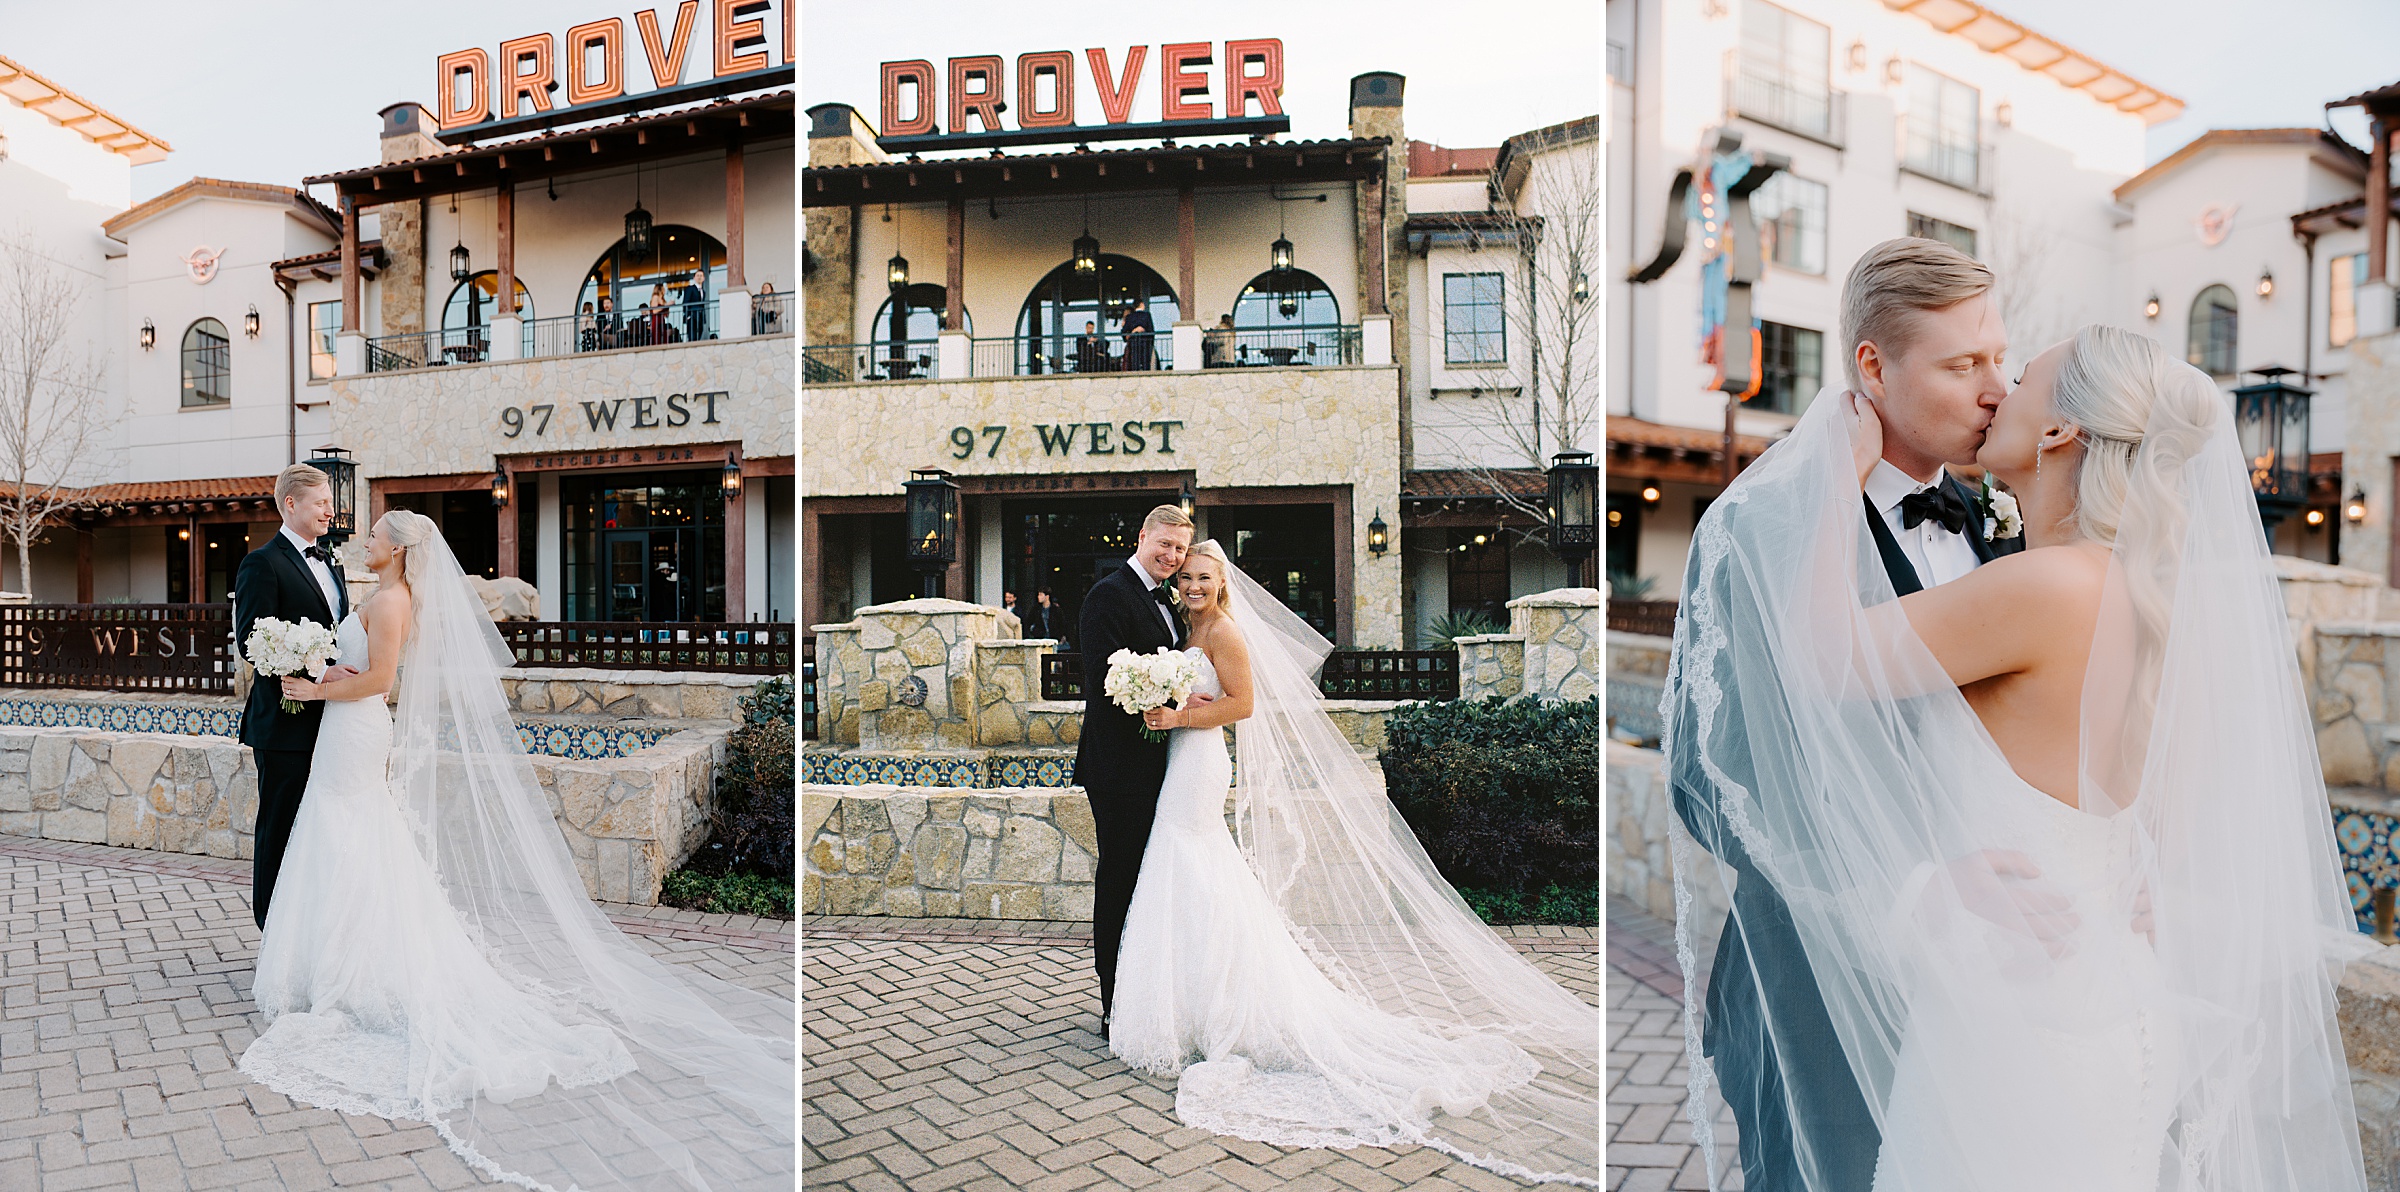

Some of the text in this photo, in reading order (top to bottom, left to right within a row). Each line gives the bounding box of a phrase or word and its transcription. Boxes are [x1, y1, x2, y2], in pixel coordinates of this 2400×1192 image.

[879, 37, 1285, 137] DROVER
[501, 390, 730, 439] 97 WEST
[950, 419, 1184, 460] 97 WEST
[534, 449, 694, 468] KITCHEN & BAR
[984, 477, 1074, 491] KITCHEN
[1111, 475, 1150, 488] BAR
[28, 626, 205, 657] 97 WEST
[134, 658, 144, 670] &
[161, 658, 202, 673] BAR
